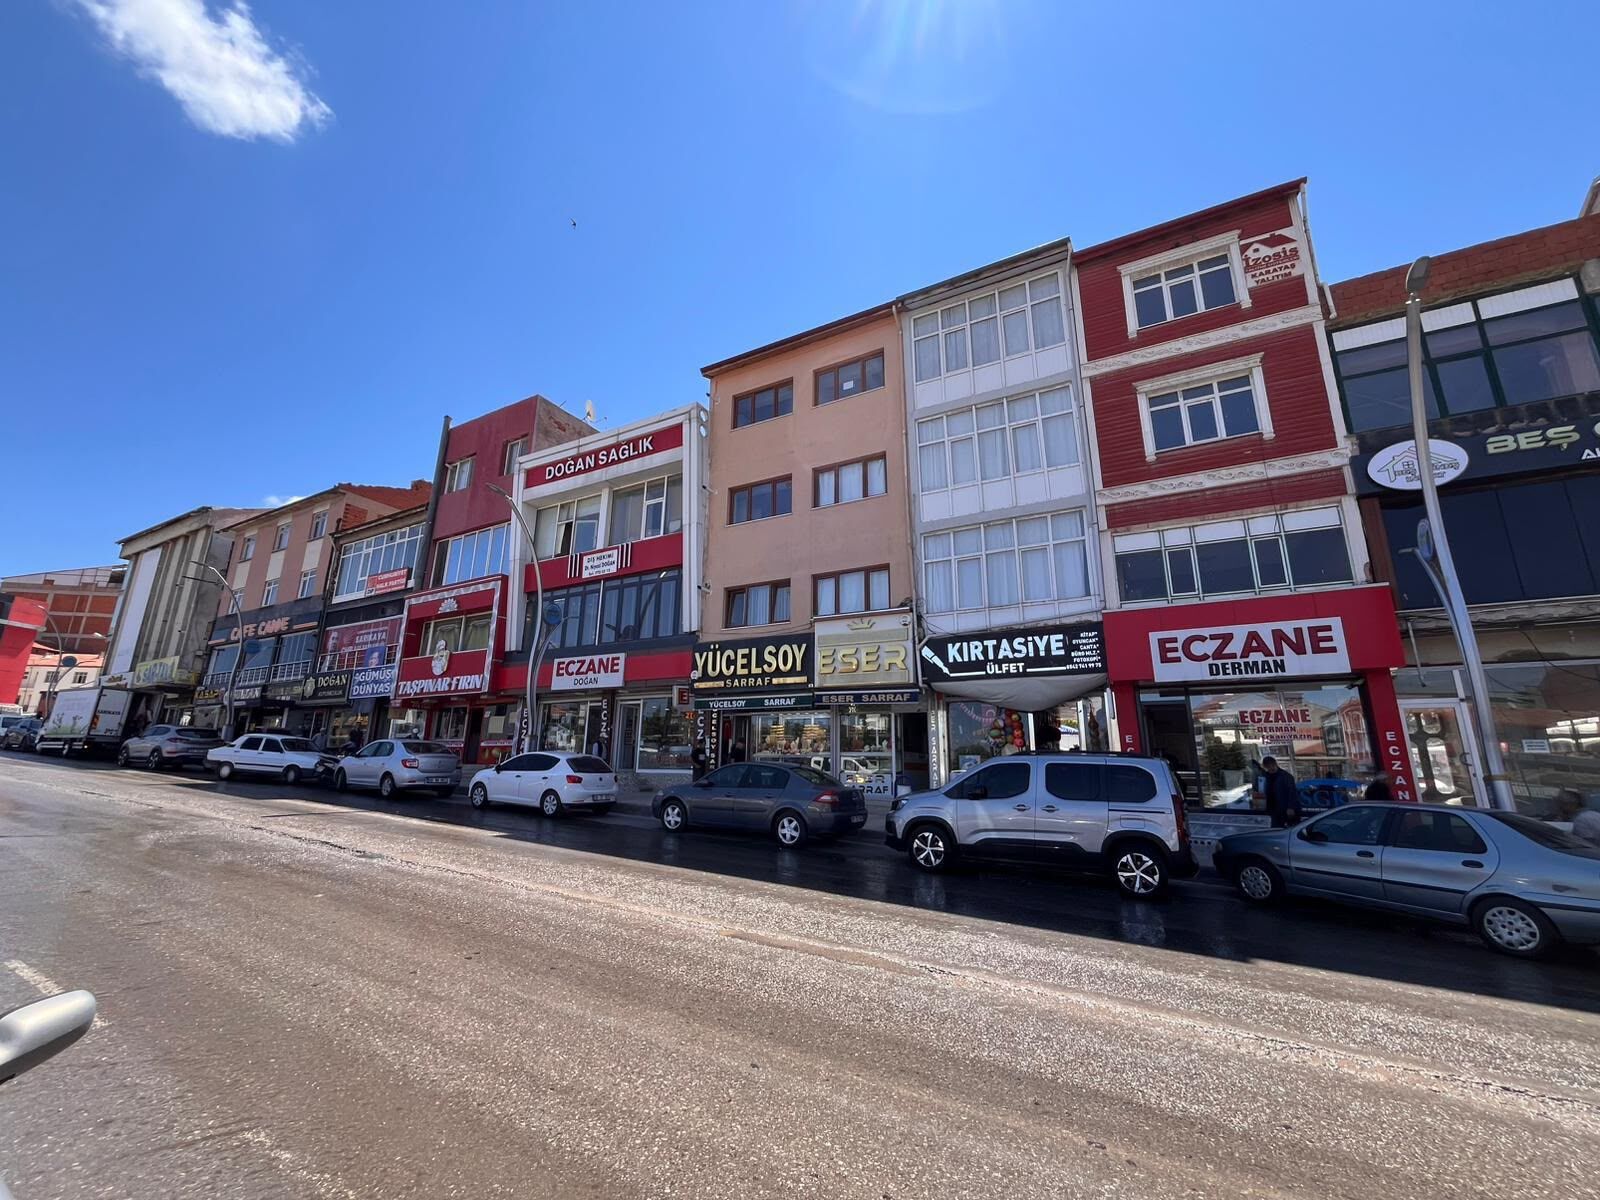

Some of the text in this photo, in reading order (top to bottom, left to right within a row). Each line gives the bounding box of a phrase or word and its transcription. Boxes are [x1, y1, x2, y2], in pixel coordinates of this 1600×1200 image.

[1486, 425, 1580, 454] BEŞ
[545, 436, 653, 480] DOĞAN SAĞLIK
[1157, 624, 1337, 664] ECZANE
[556, 656, 620, 677] ECZANE
[694, 643, 807, 678] YÜCELSOY
[818, 645, 907, 674] ESER
[986, 662, 1025, 675] ÜLFET
[1208, 658, 1286, 677] DERMAN
[318, 674, 348, 687] DOĞAN
[399, 674, 484, 696] TAŞPINAR FIRIN
[573, 677, 598, 686] DOĞAN
[725, 676, 771, 688] SARRAF
[708, 697, 796, 709] YÜCELSOY SARRAF
[822, 693, 911, 703] ESER SARRAF
[1239, 709, 1311, 723] ECZANE
